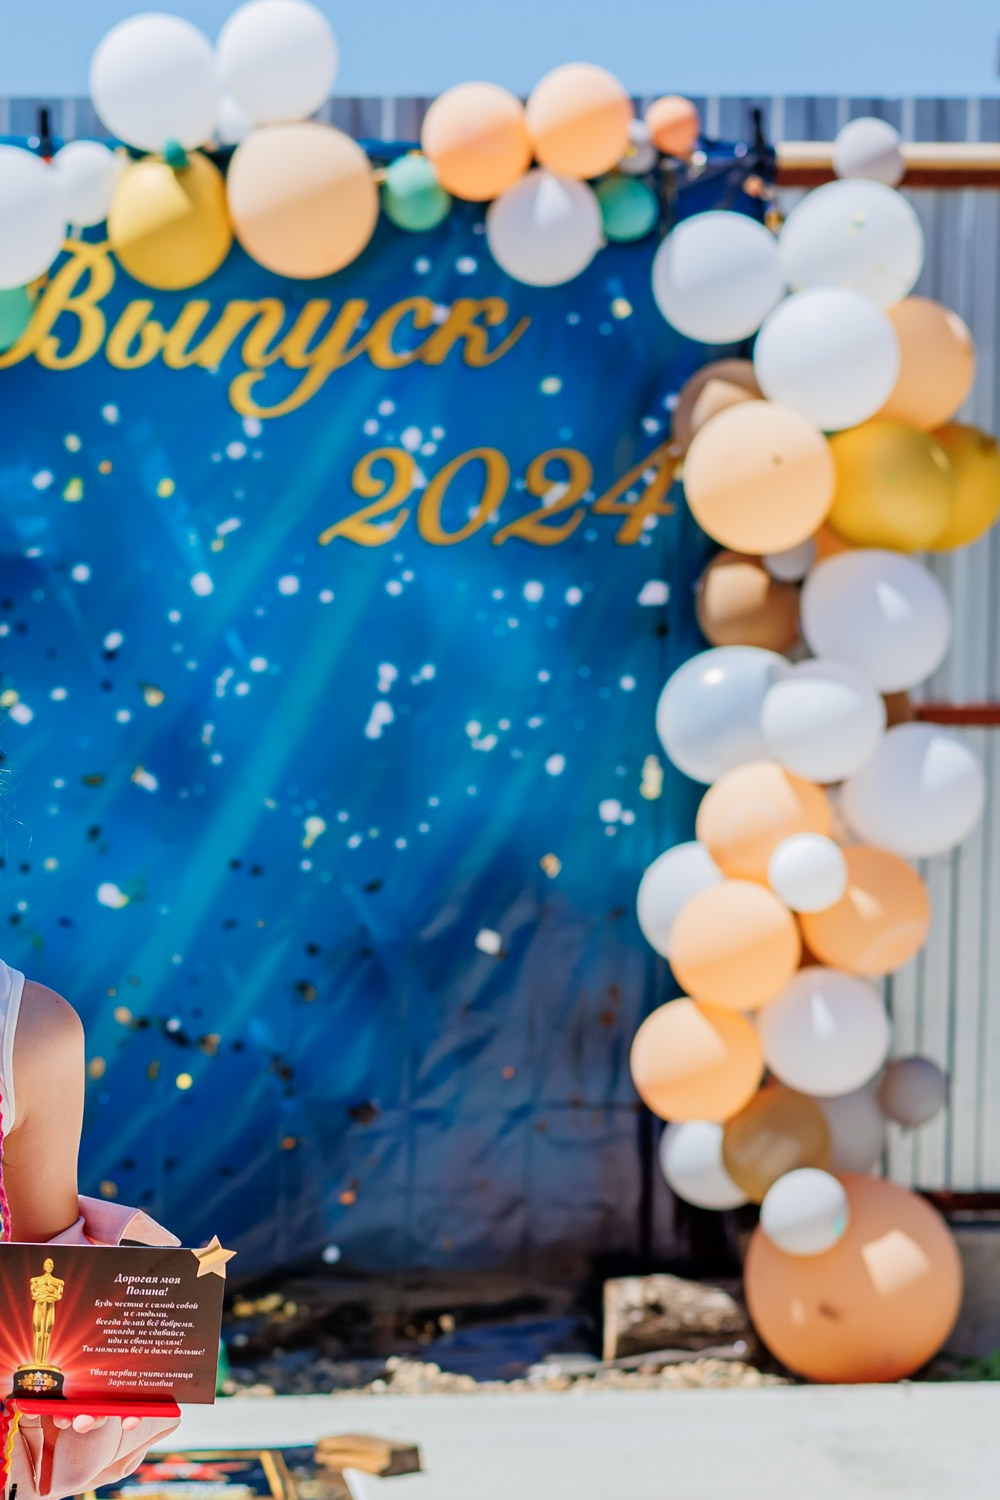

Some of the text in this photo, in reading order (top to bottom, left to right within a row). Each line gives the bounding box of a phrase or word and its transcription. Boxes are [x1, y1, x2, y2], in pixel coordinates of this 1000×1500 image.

[318, 438, 680, 546] 2024
[114, 1273, 181, 1285] Дорогая моя
[126, 1286, 169, 1297] Полина!
[94, 1299, 113, 1309] Будь
[114, 1301, 144, 1309] честна
[150, 1301, 175, 1309] самой
[176, 1302, 199, 1310] собой
[95, 1317, 121, 1326] всегда
[122, 1318, 145, 1327] делай
[146, 1318, 159, 1327] всё
[103, 1328, 136, 1336] никогда
[107, 1336, 122, 1344] иди
[130, 1337, 154, 1345] своим
[155, 1338, 183, 1346] целям!
[82, 1344, 94, 1352] Ты
[130, 1345, 143, 1354] всё
[151, 1347, 173, 1355] даже
[174, 1347, 206, 1356] больше!
[89, 1368, 194, 1380] Твоя первая учительница
[107, 1378, 174, 1388] Зарема Кимовна
